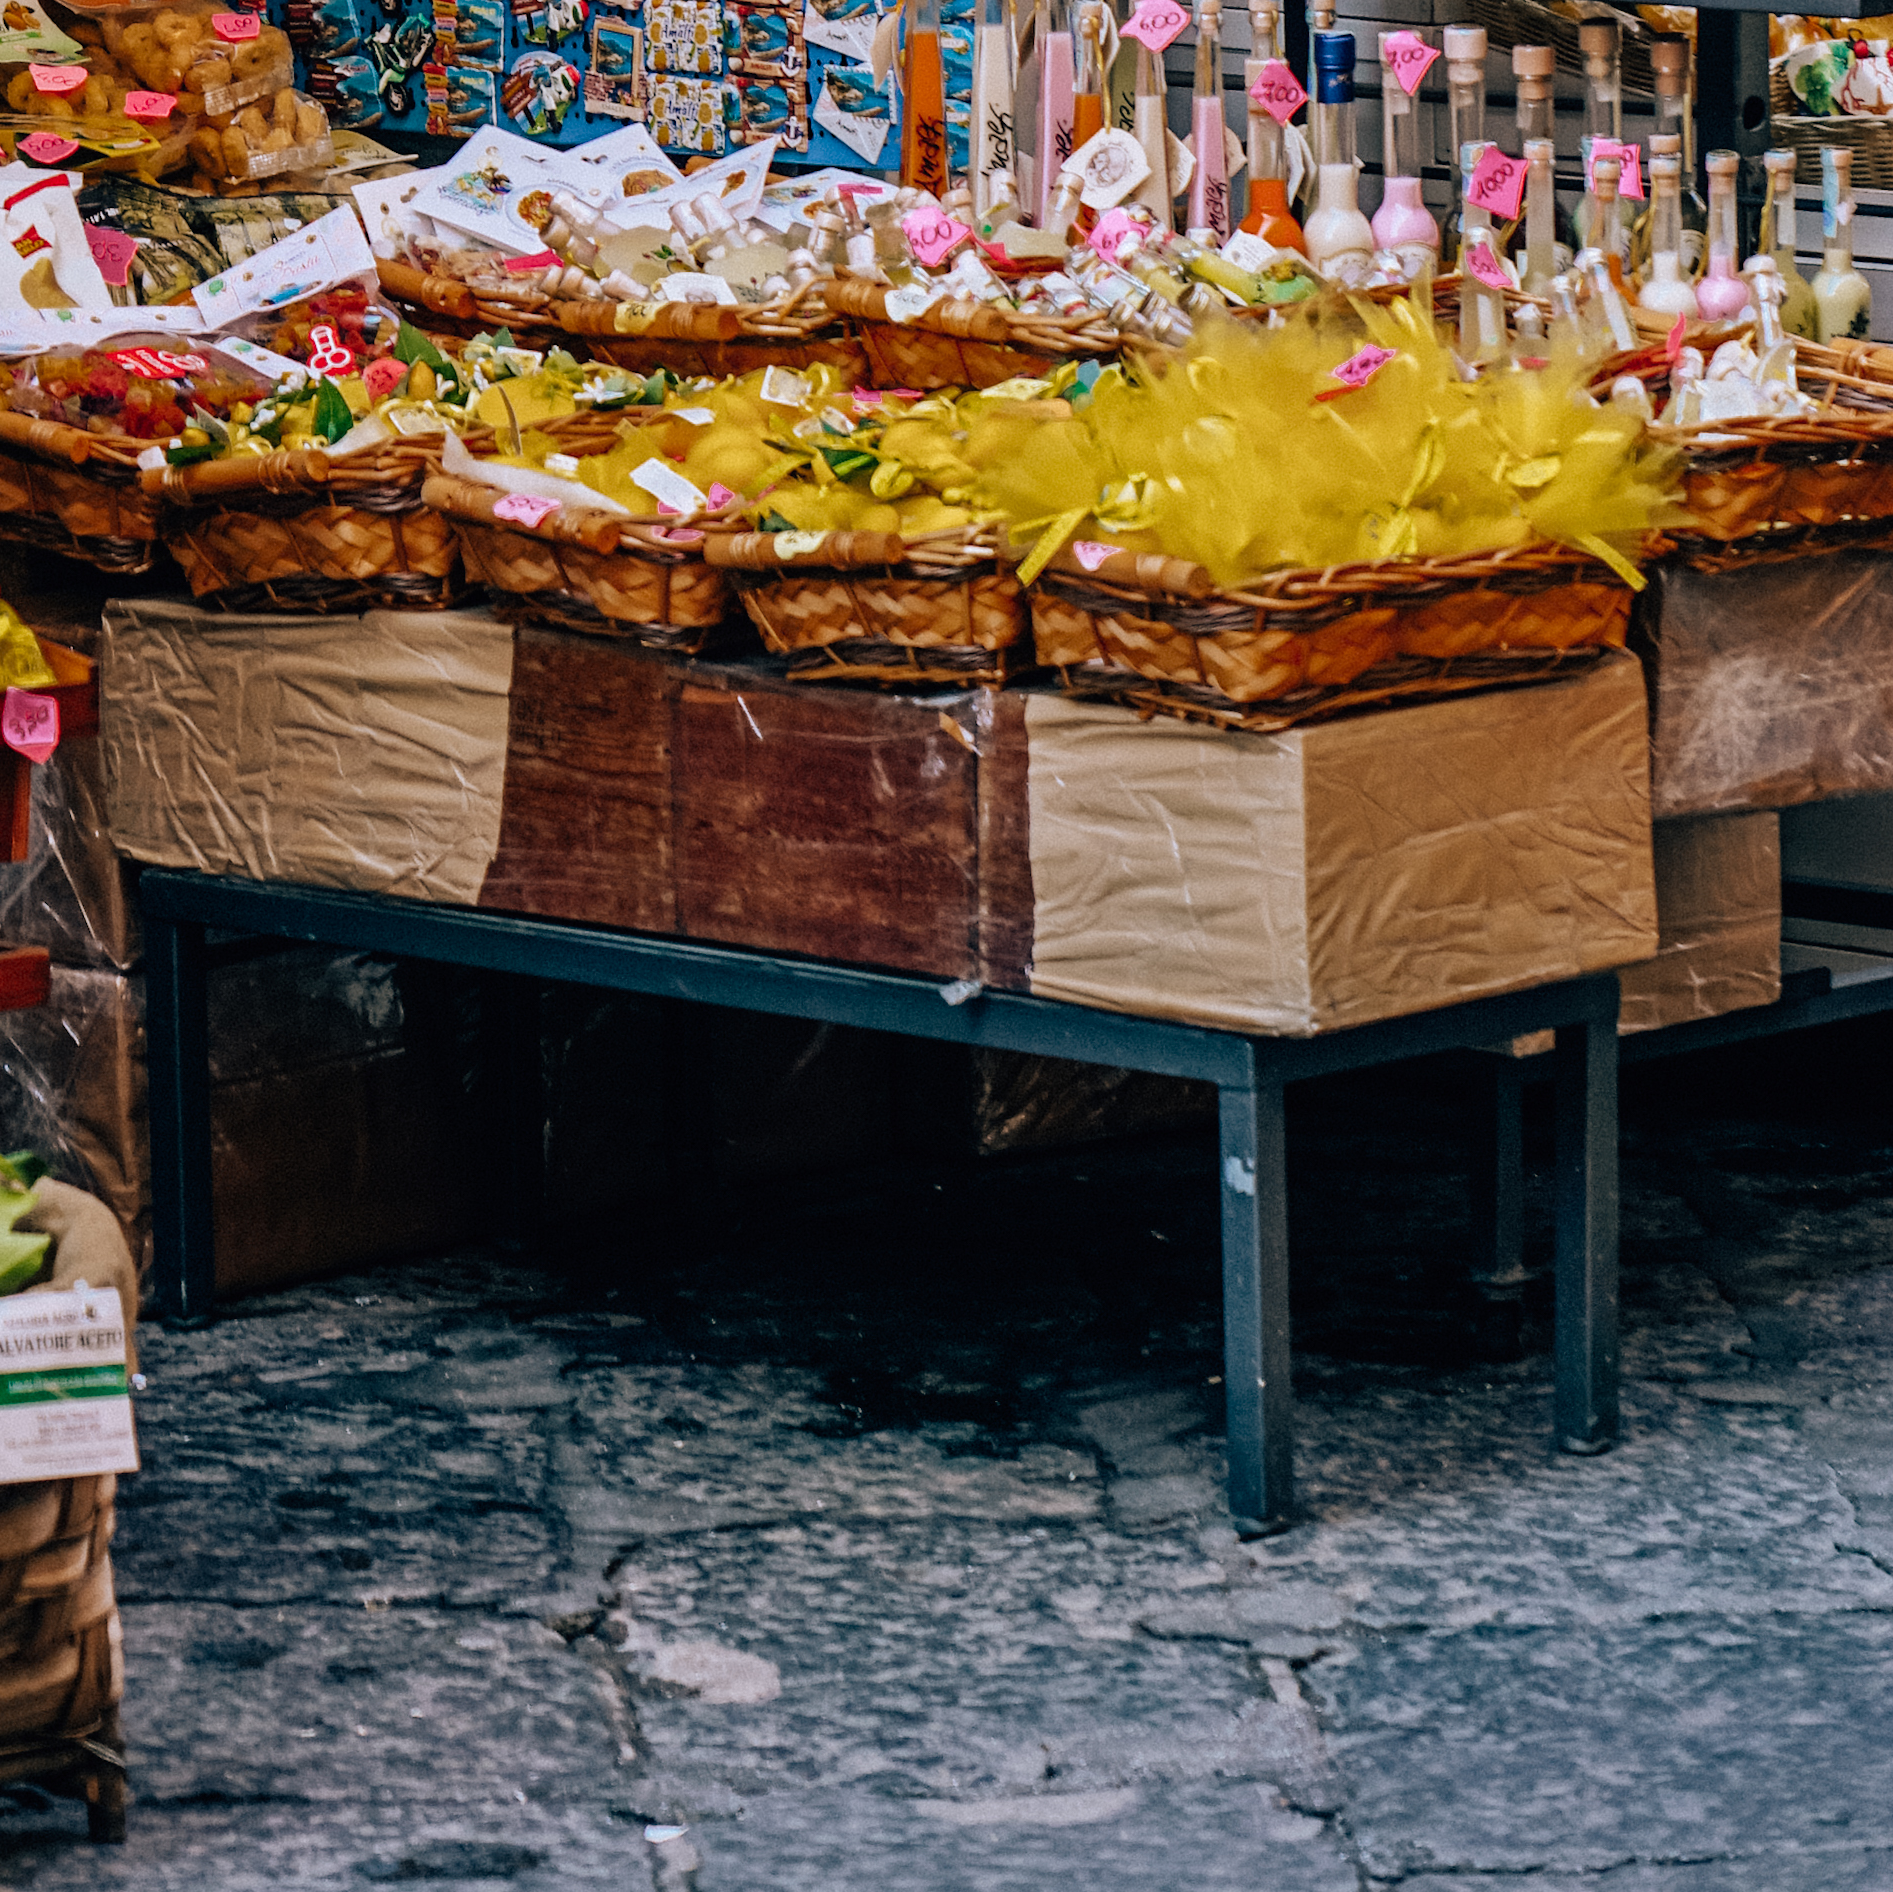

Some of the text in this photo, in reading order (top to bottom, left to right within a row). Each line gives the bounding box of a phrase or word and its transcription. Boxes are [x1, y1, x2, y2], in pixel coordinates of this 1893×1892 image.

[660, 21, 695, 42] Amalfi
[663, 98, 699, 120] Amalfi
[63, 1327, 123, 1349] ACETO
